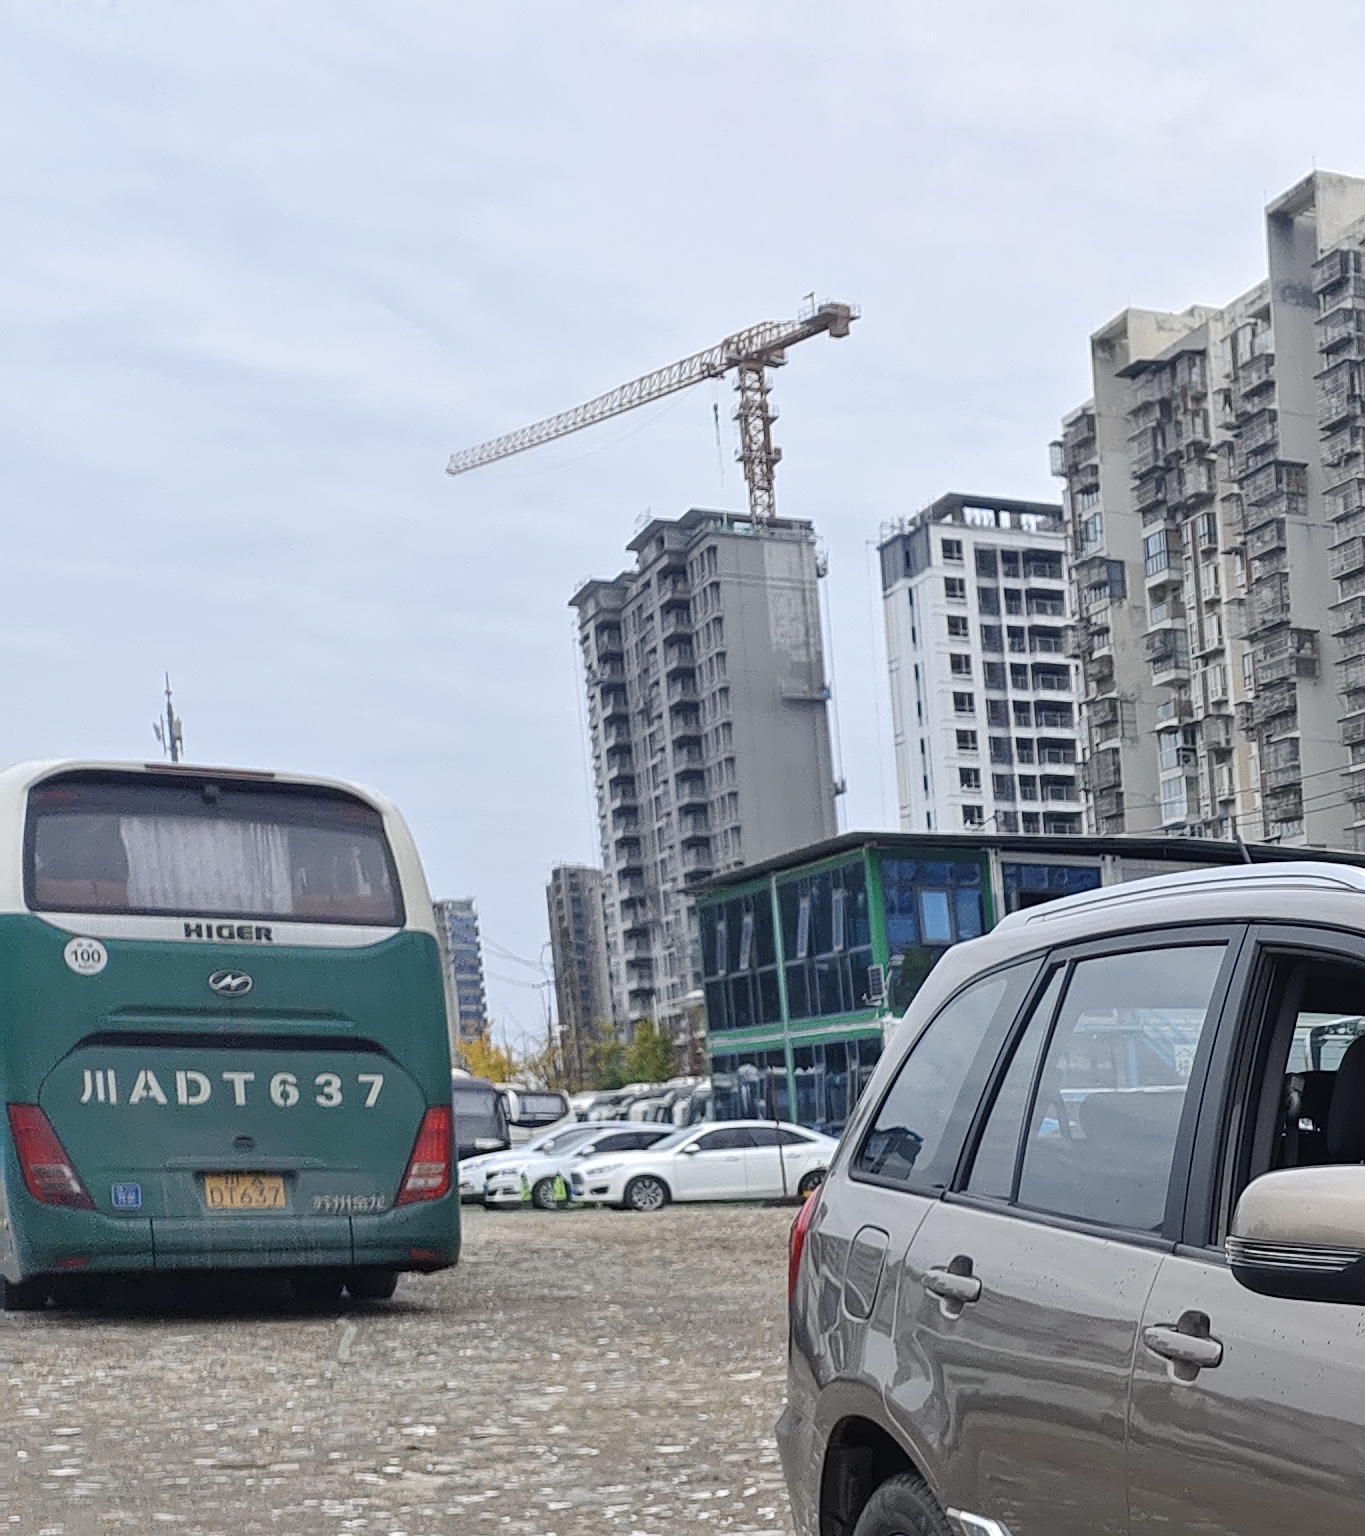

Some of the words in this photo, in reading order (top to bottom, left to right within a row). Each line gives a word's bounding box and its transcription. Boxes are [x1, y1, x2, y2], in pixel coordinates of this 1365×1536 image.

[184, 923, 273, 941] HIGER
[70, 949, 101, 964] 100
[81, 1068, 385, 1108] 川ADT637
